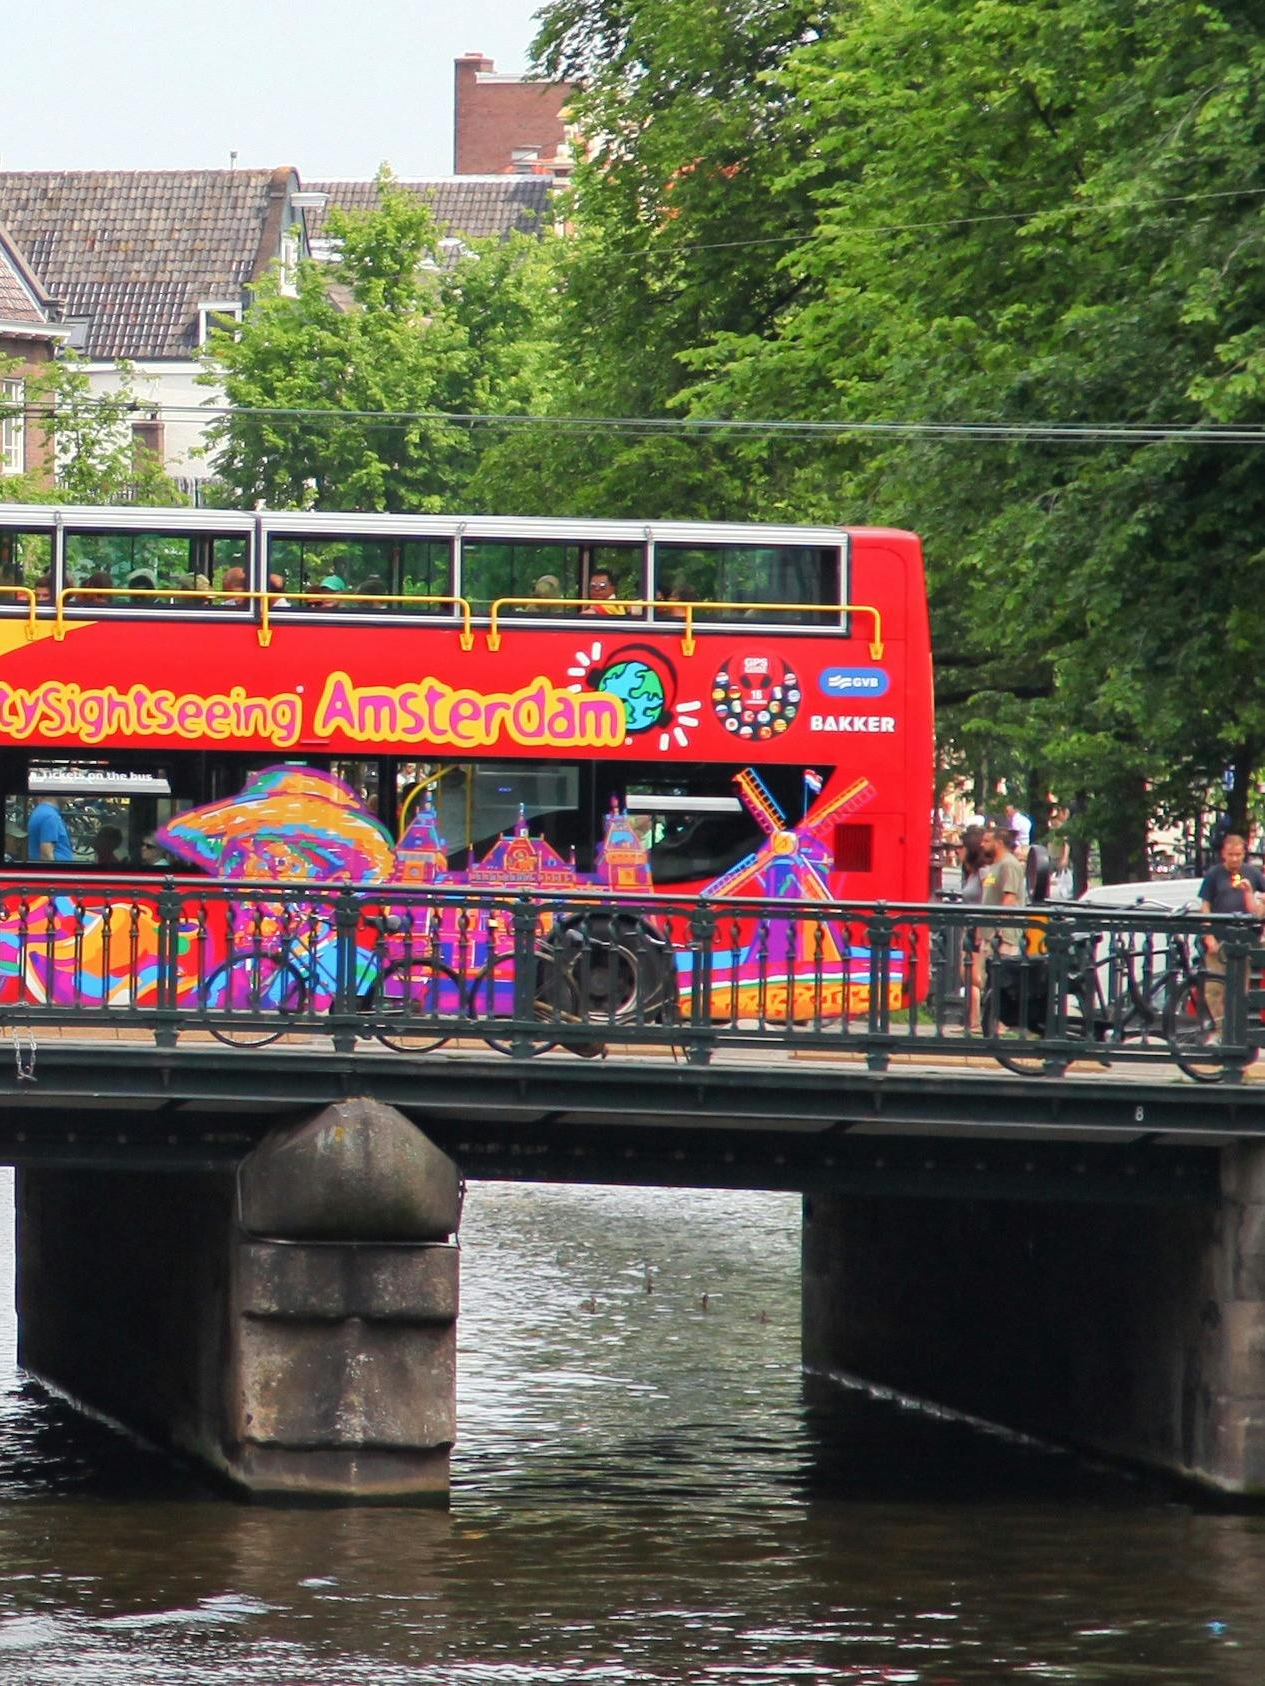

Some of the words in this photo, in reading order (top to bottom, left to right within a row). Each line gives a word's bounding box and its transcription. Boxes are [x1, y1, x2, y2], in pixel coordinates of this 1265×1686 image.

[852, 677, 879, 688] GVB
[315, 671, 625, 748] Amsterdam
[810, 715, 896, 733] BAKKER
[88, 772, 104, 780] on
[106, 770, 128, 781] the
[129, 771, 153, 782] bus
